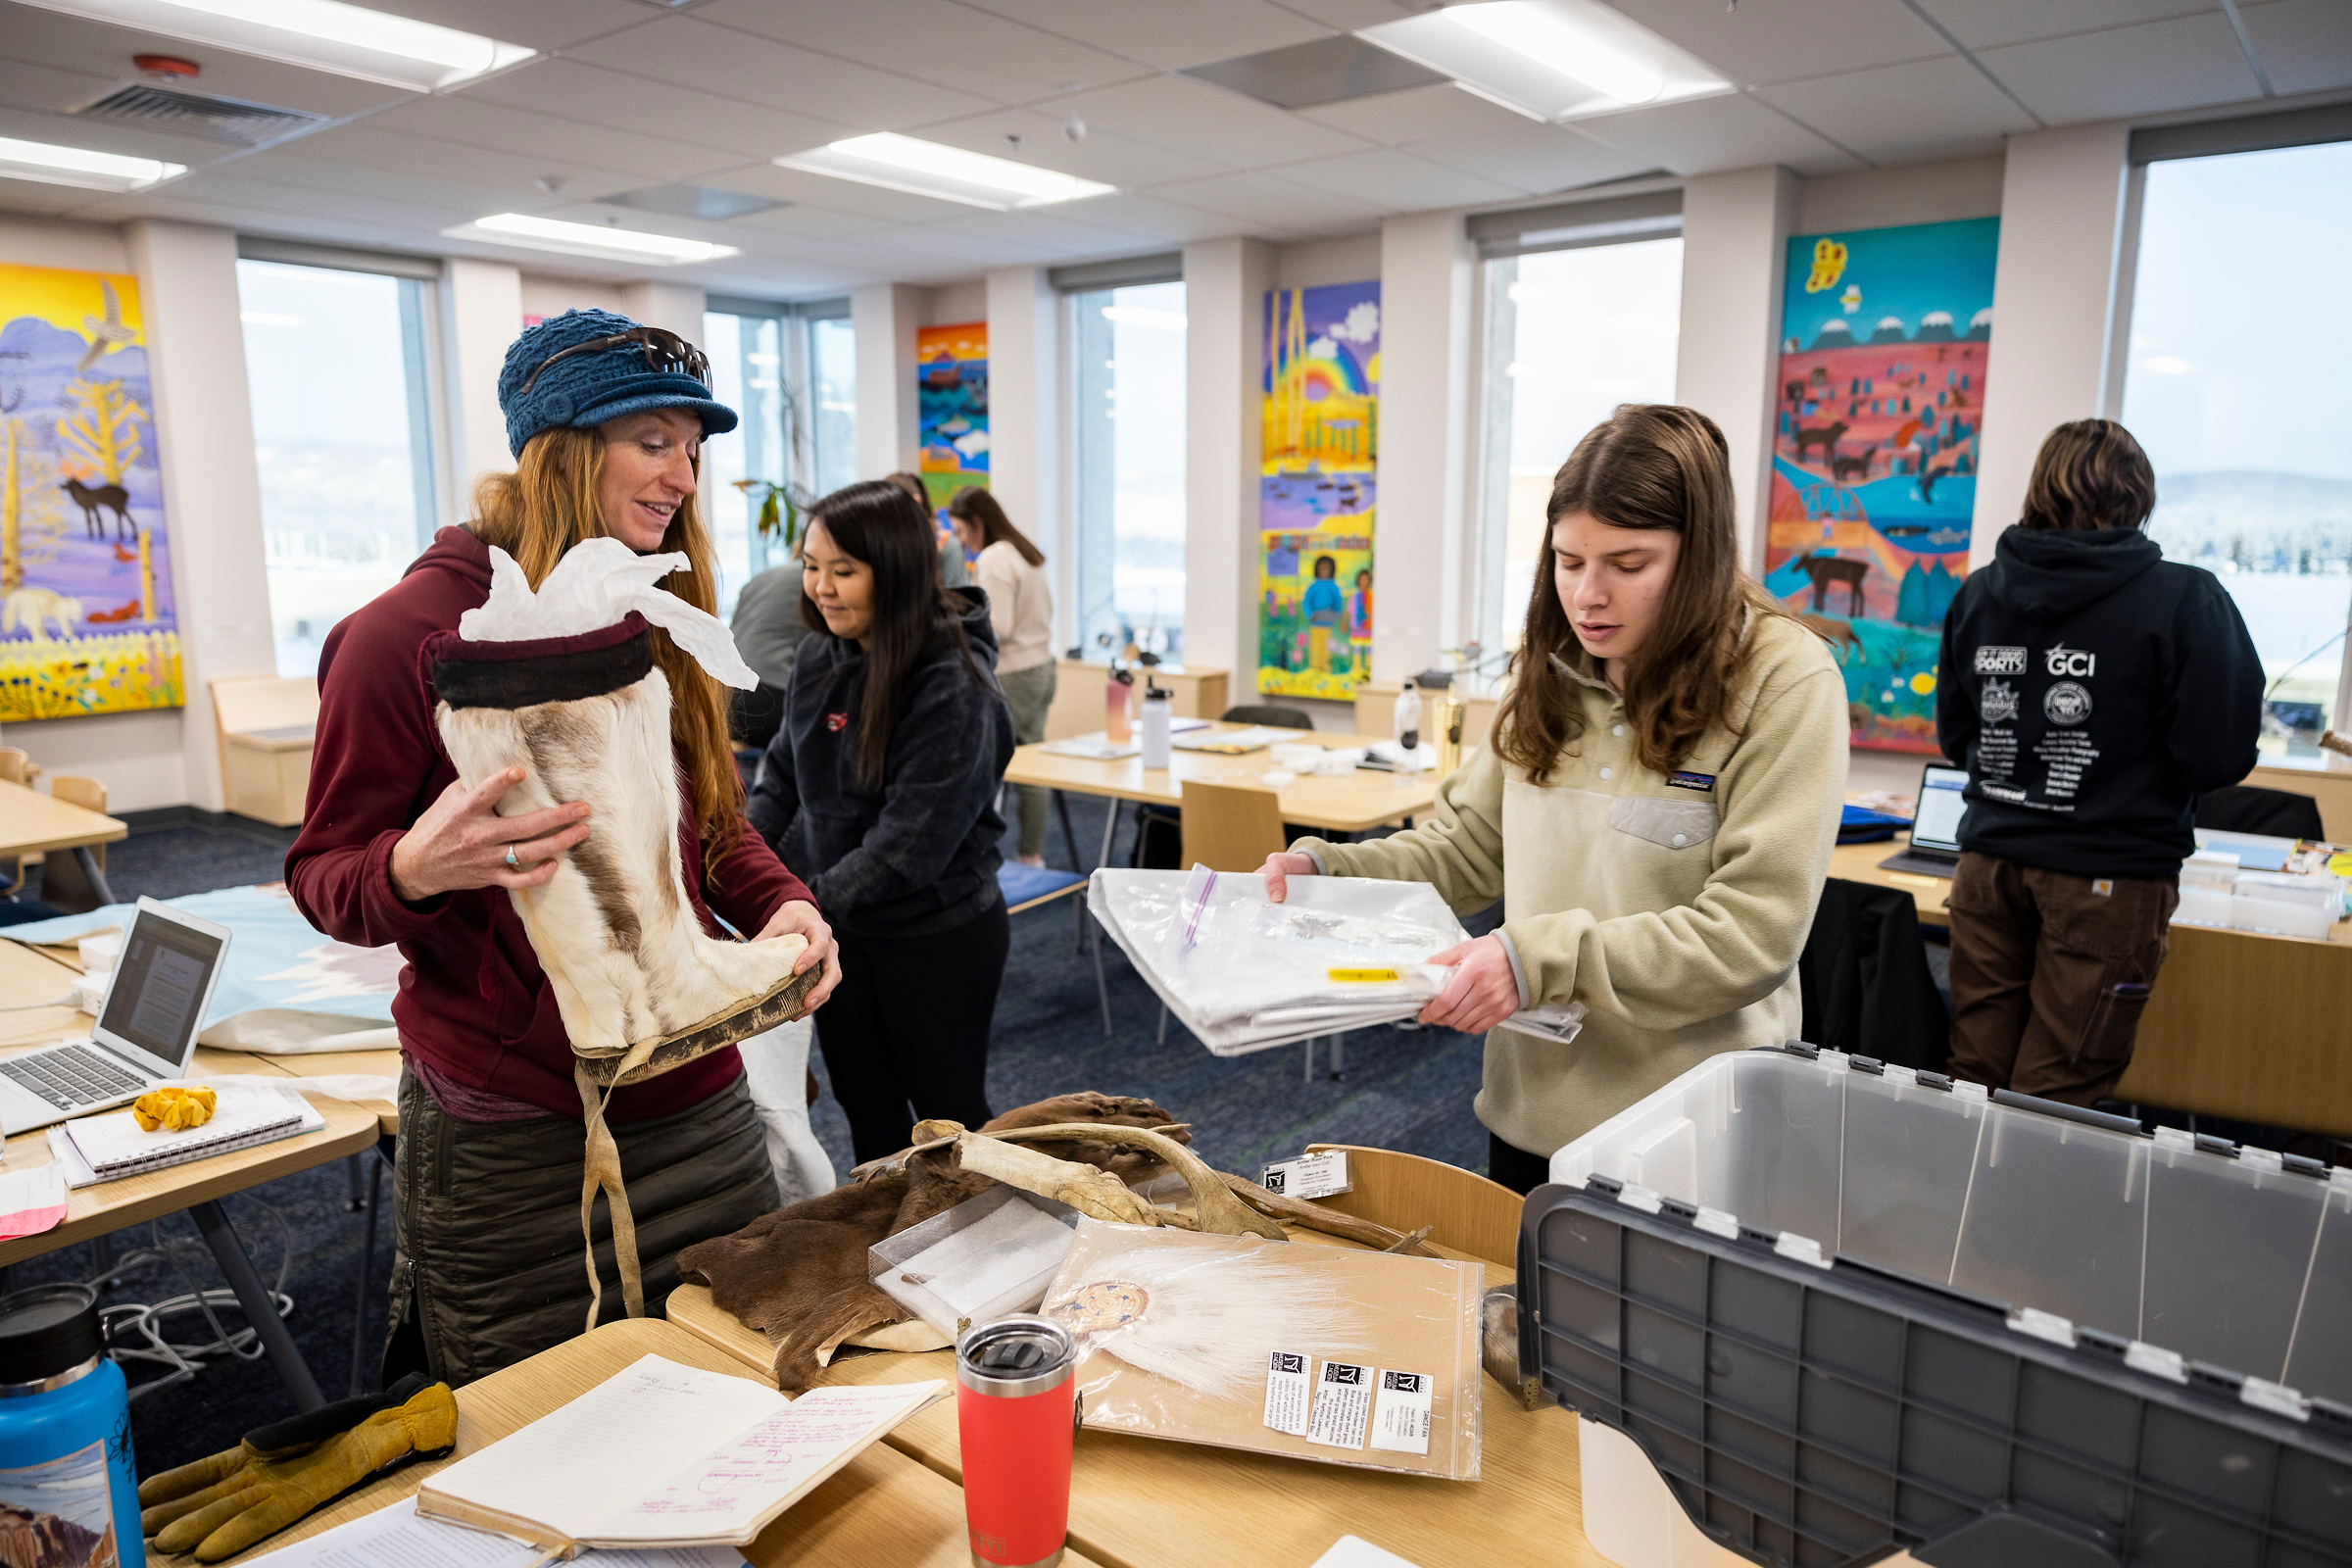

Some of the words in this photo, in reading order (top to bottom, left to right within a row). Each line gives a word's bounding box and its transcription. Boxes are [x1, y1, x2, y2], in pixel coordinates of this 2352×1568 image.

[1976, 659, 2024, 671] SPORTS
[2047, 654, 2095, 676] GCI
[971, 1531, 1002, 1552] YETI
